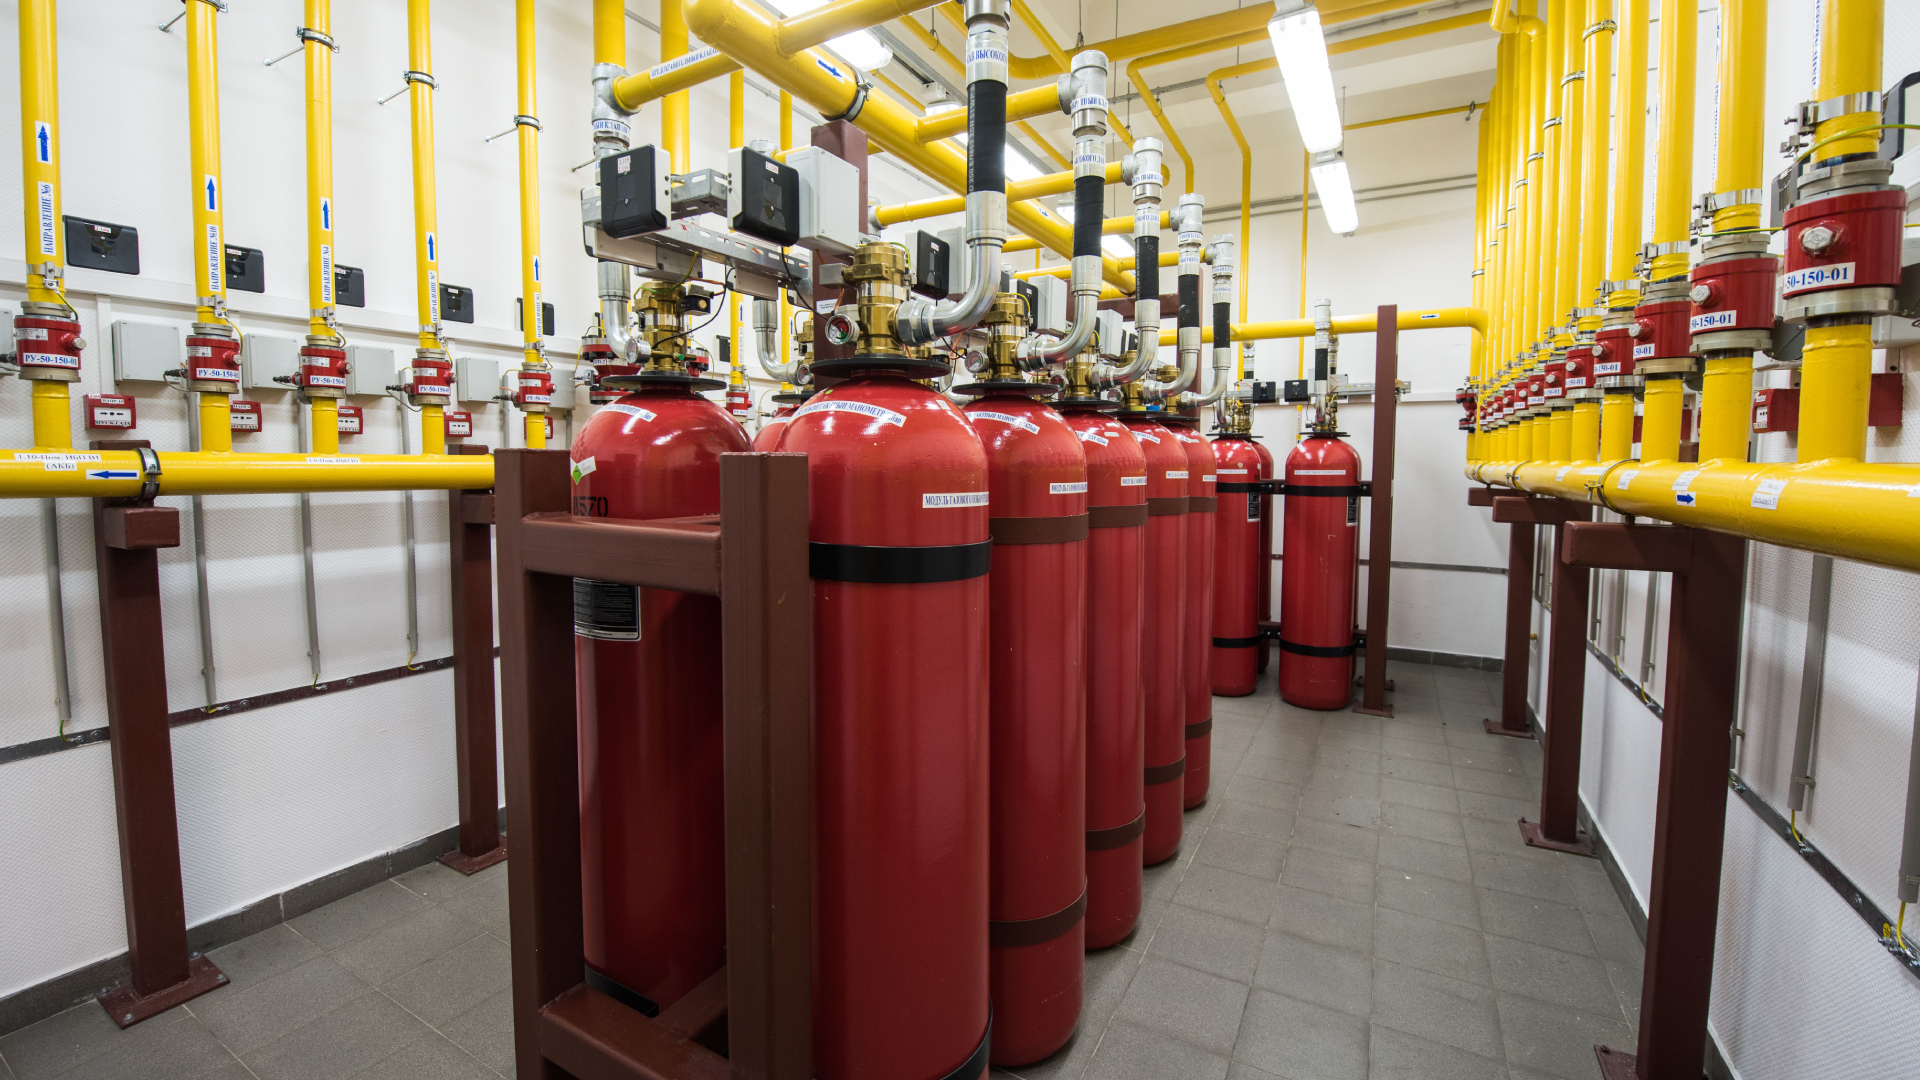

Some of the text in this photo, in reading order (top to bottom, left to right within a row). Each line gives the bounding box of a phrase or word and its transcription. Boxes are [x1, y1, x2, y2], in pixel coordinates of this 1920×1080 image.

[41, 196, 54, 254] НАПРАВЛЕНИЕ
[209, 240, 219, 291] НАПРАВЛЕНИЕ
[322, 256, 331, 302] НАПРАВЛЕНИЕ
[24, 354, 78, 366] РУ-50-150-01
[847, 402, 886, 417] МАНОМЕТР
[46, 462, 76, 470] (АКБ)
[572, 495, 609, 518] 8570
[925, 495, 949, 507] МОДУЛЬ
